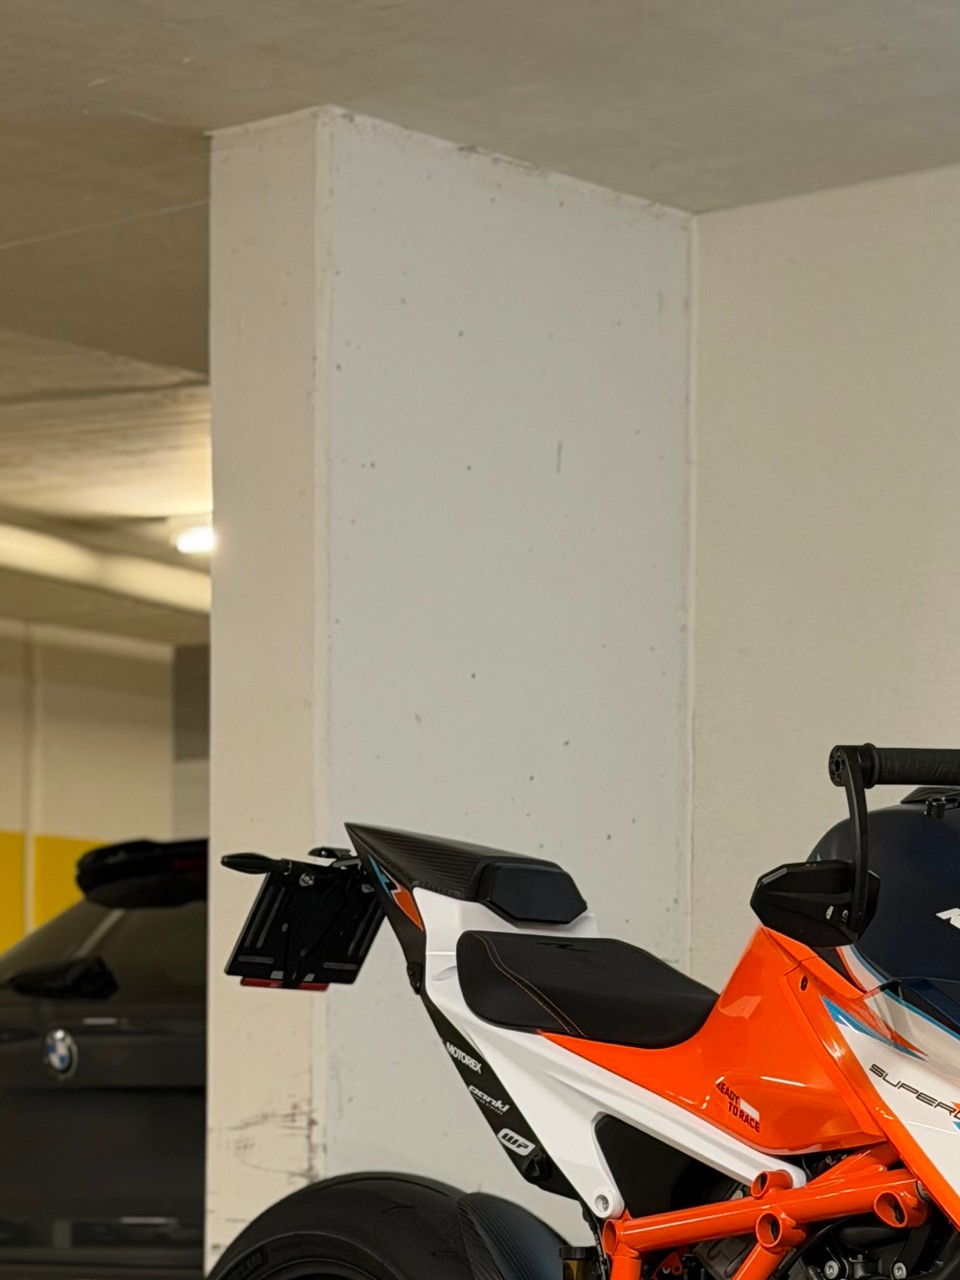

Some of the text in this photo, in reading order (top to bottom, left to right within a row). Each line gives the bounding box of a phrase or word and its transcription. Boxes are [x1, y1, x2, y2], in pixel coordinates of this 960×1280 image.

[446, 1041, 482, 1074] MOTOREX
[715, 1081, 740, 1105] READY
[728, 1101, 761, 1133] TO RACE
[501, 1132, 530, 1150] WP
